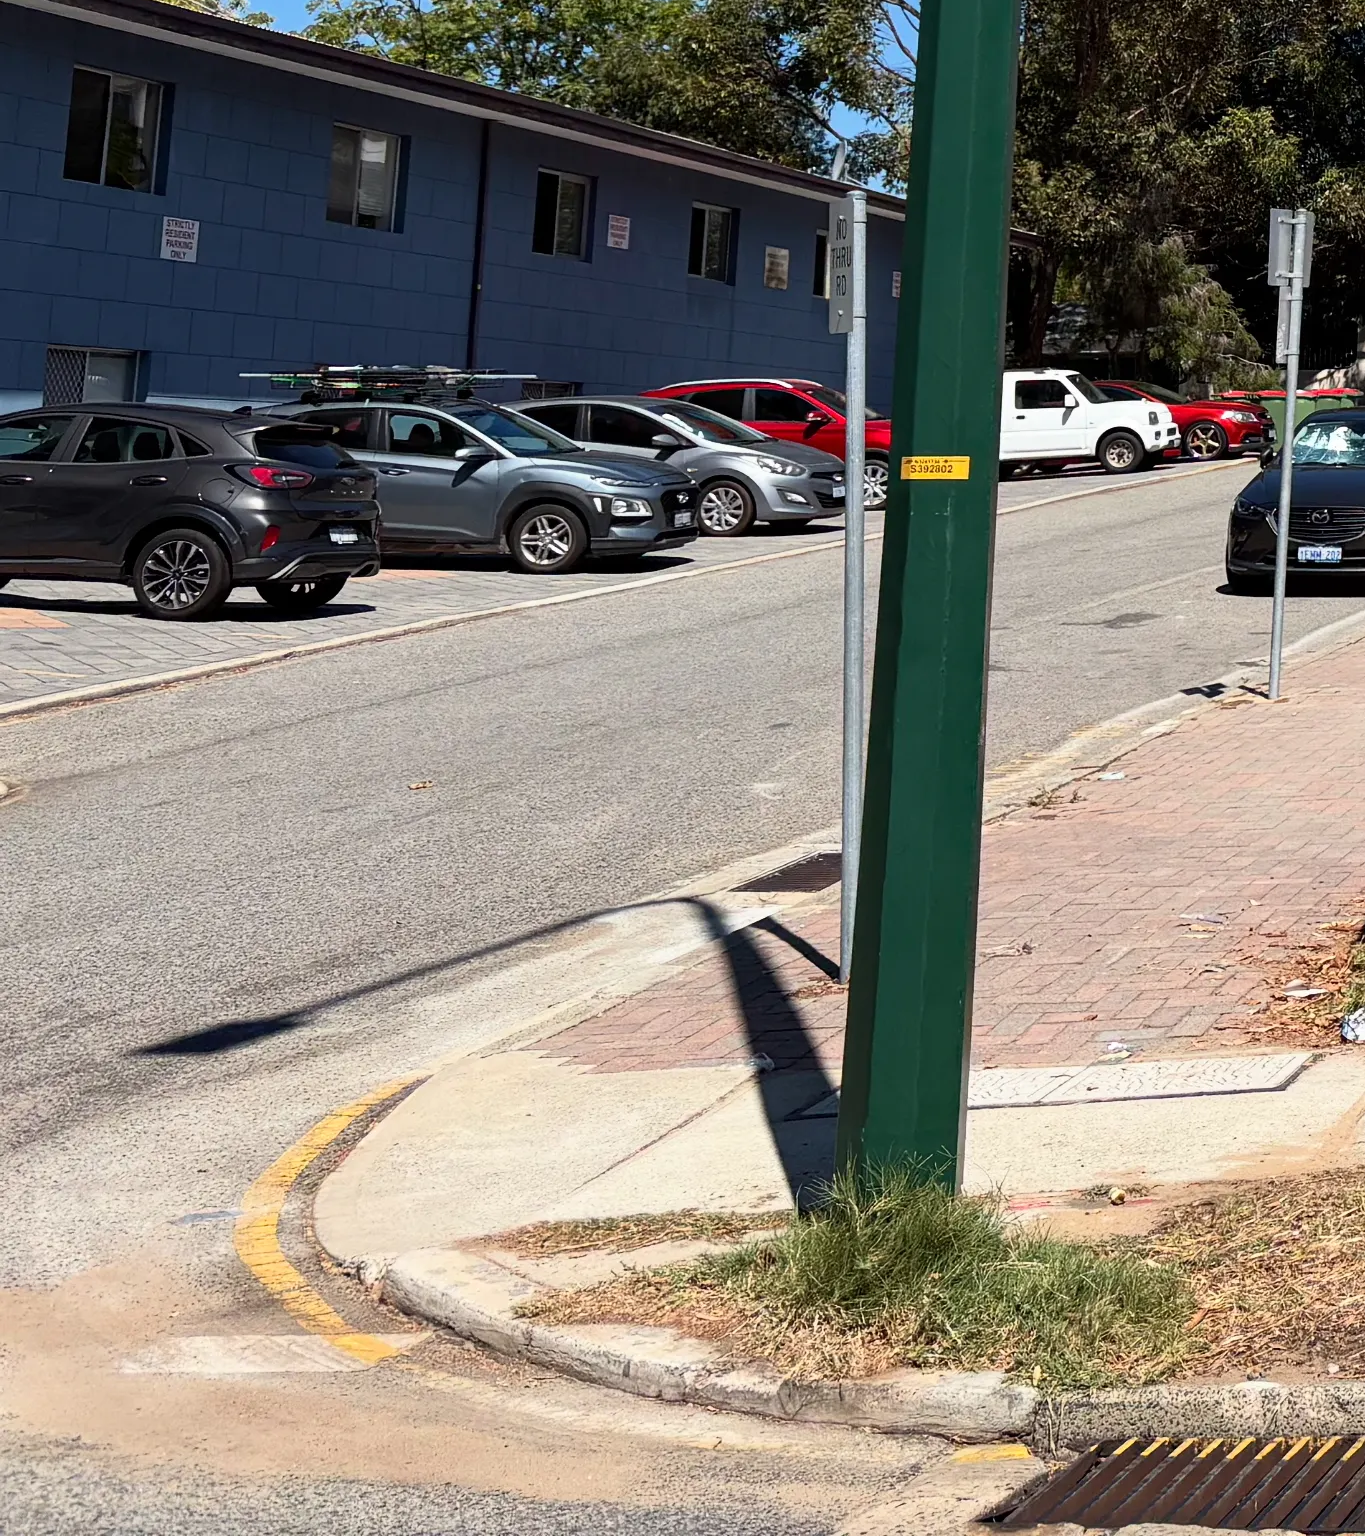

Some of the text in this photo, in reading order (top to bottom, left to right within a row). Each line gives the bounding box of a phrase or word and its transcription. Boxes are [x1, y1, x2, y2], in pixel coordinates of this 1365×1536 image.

[167, 218, 195, 230] STRICTLY
[836, 218, 848, 241] NO
[166, 239, 194, 250] PARKING
[171, 250, 187, 259] ONLY
[830, 246, 852, 268] THRU
[836, 275, 847, 296] RD
[910, 465, 953, 473] S392802
